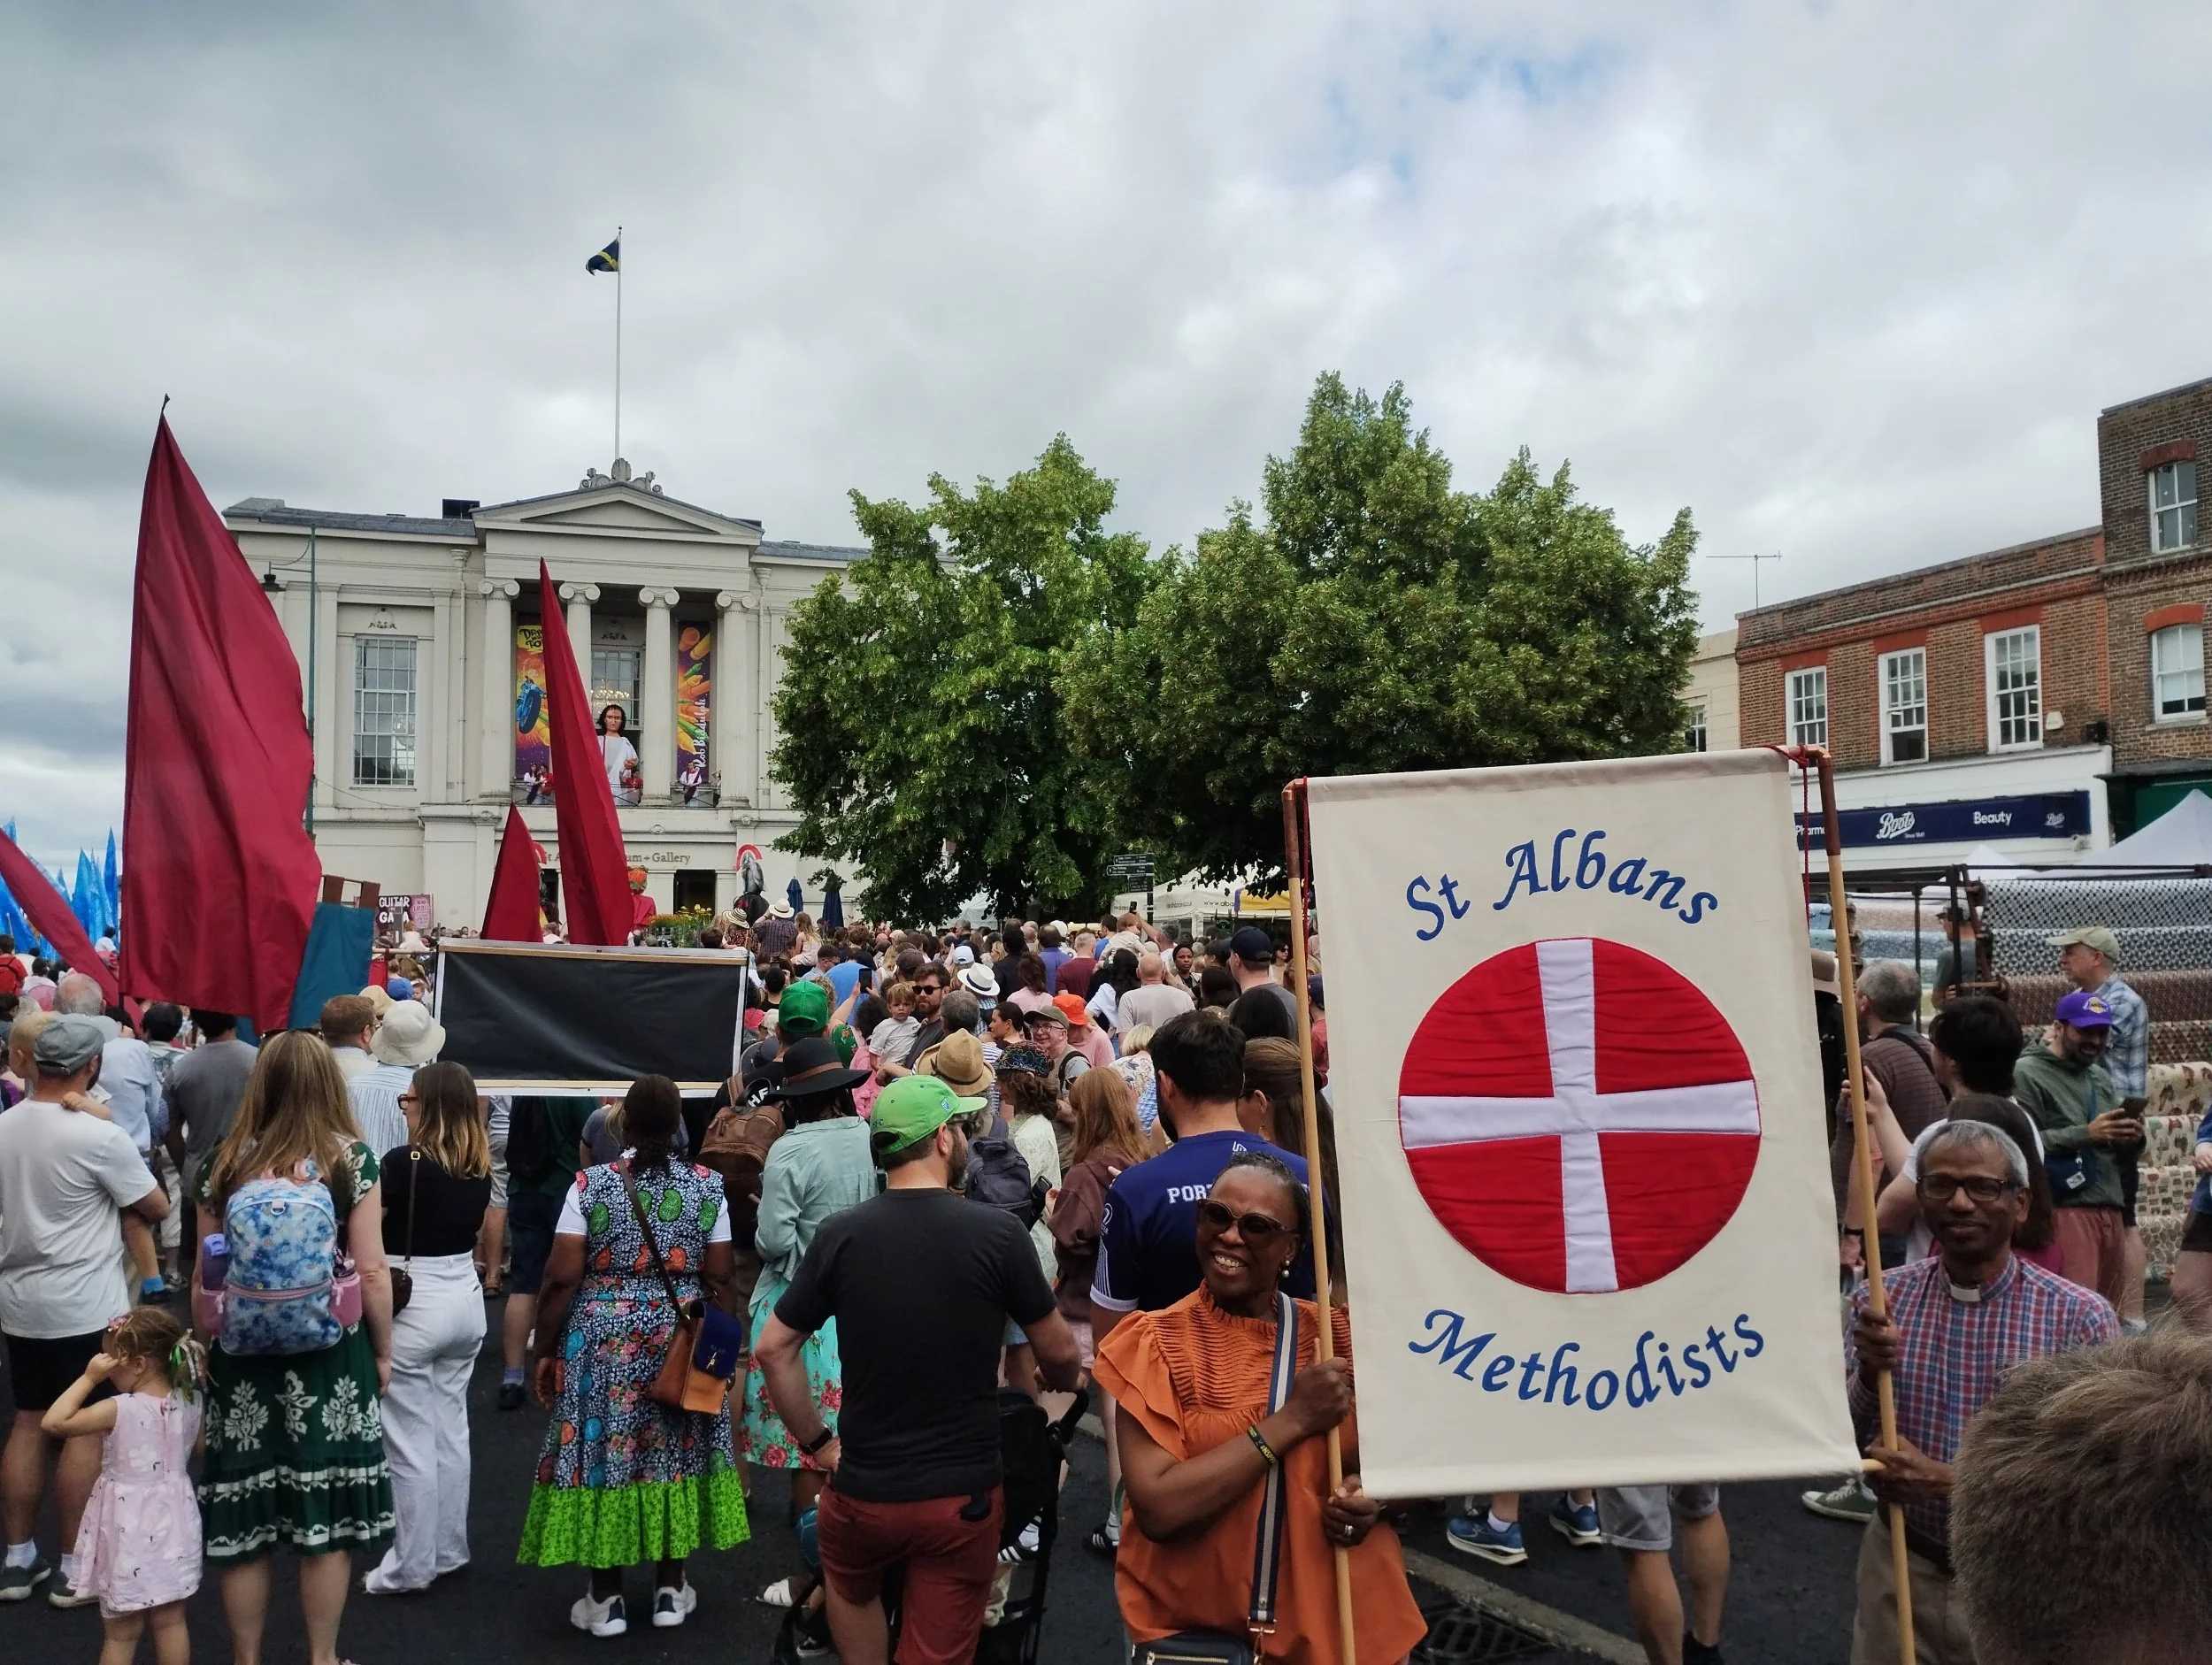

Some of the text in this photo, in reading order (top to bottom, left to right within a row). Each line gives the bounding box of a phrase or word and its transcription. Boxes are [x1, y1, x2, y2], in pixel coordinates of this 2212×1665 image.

[692, 749, 707, 771] Rob
[1876, 811, 1916, 839] Boots
[1973, 810, 2012, 826] Beauty
[652, 852, 690, 864] Gallery
[1406, 828, 1718, 940] St Albans
[379, 896, 410, 908] GUITAR
[379, 911, 410, 923] GAA
[1408, 1309, 1764, 1411] Methodists
